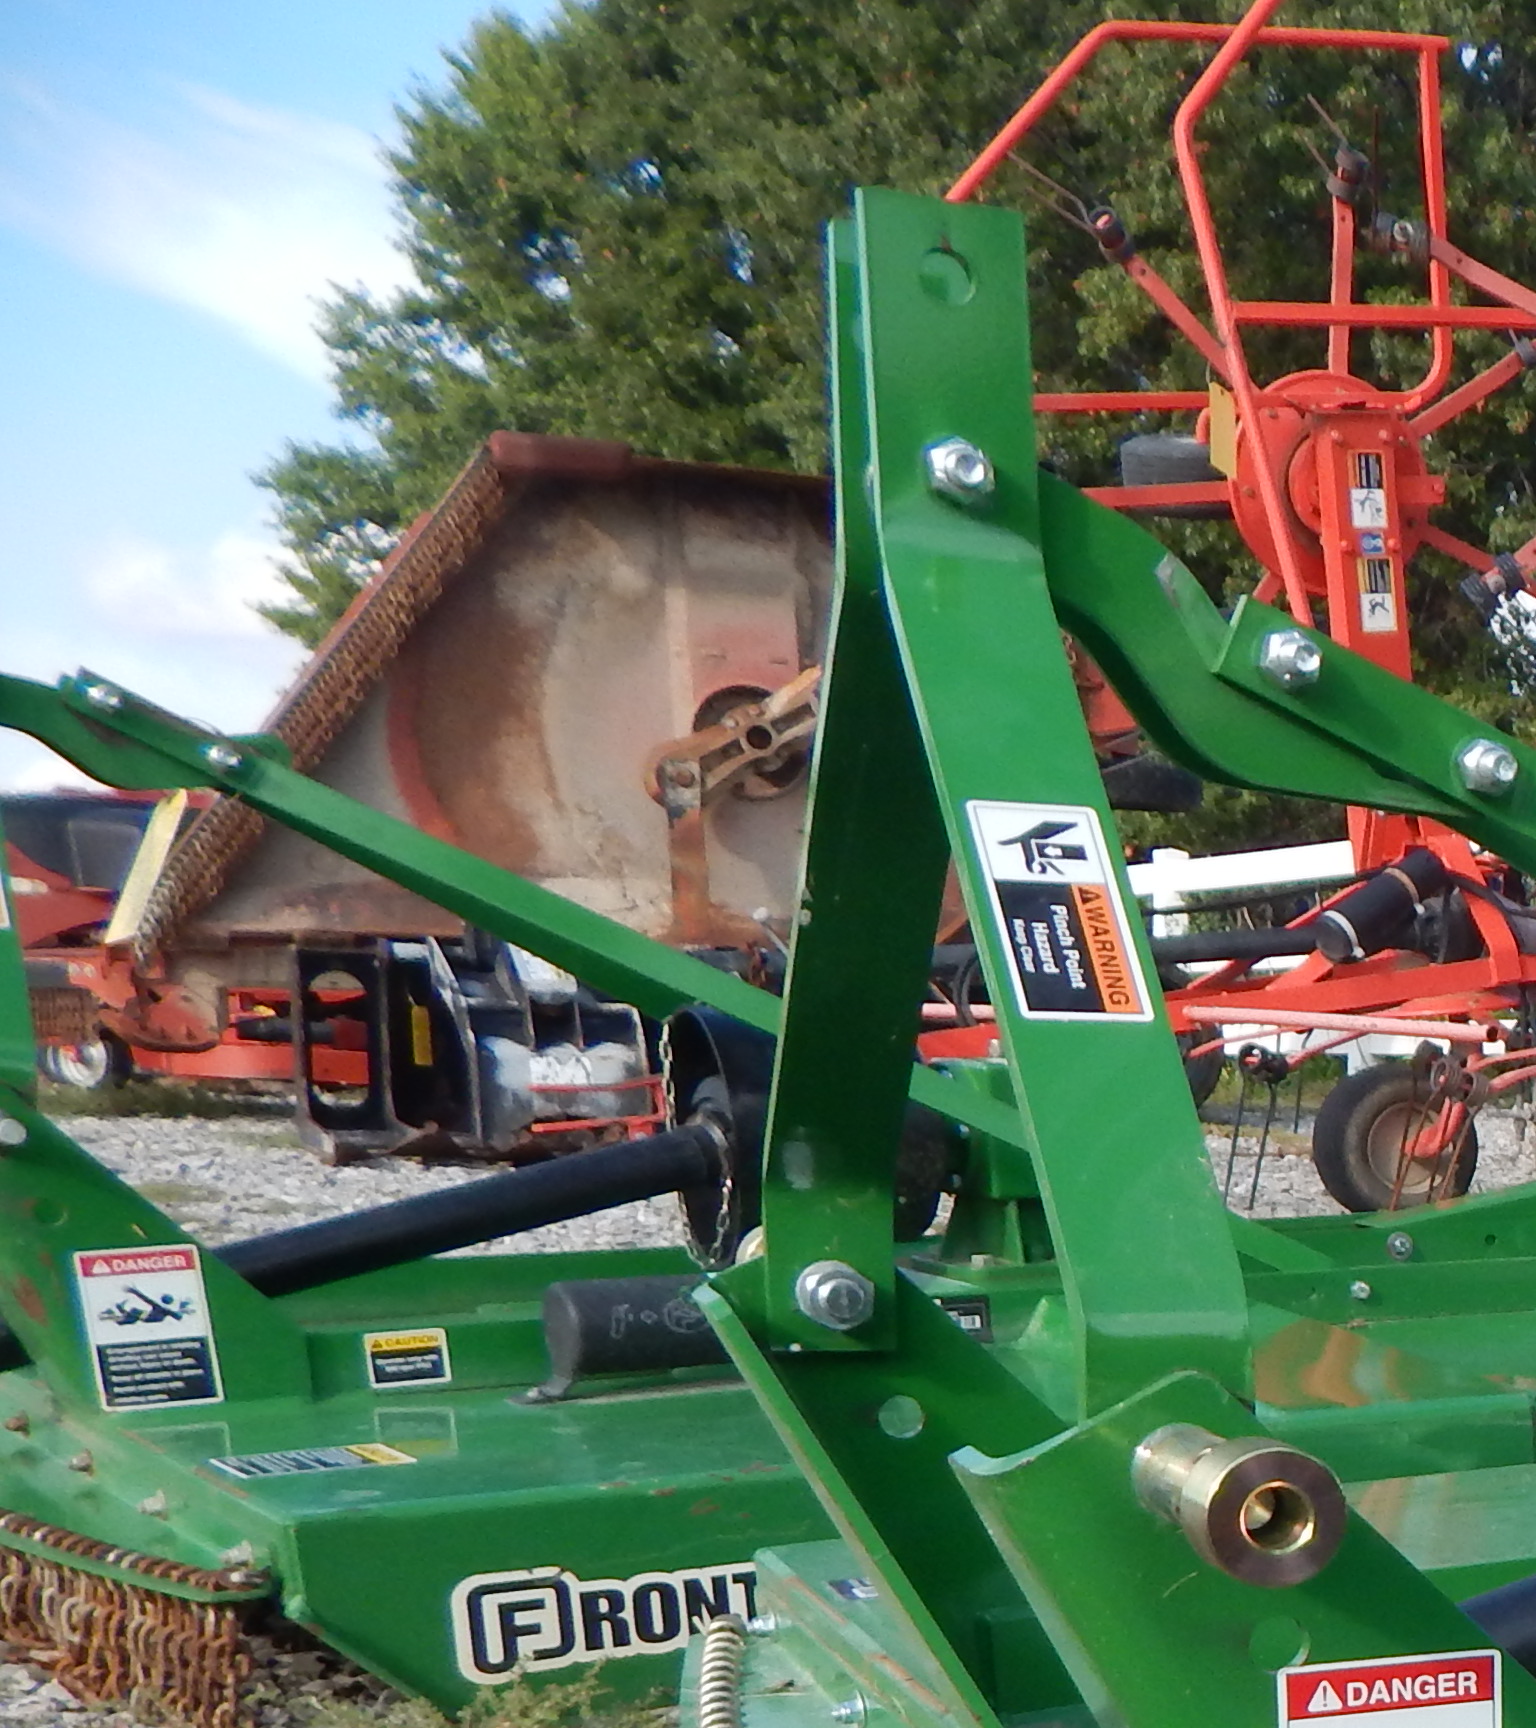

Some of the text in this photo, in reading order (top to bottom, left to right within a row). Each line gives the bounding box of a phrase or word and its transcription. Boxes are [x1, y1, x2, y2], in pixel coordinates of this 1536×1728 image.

[1030, 922, 1060, 973] Hazard
[1049, 904, 1088, 989] Pinch Point
[1083, 905, 1130, 1005] WARNING
[112, 1255, 187, 1272] DANGER
[1346, 1671, 1478, 1707] DANGER
